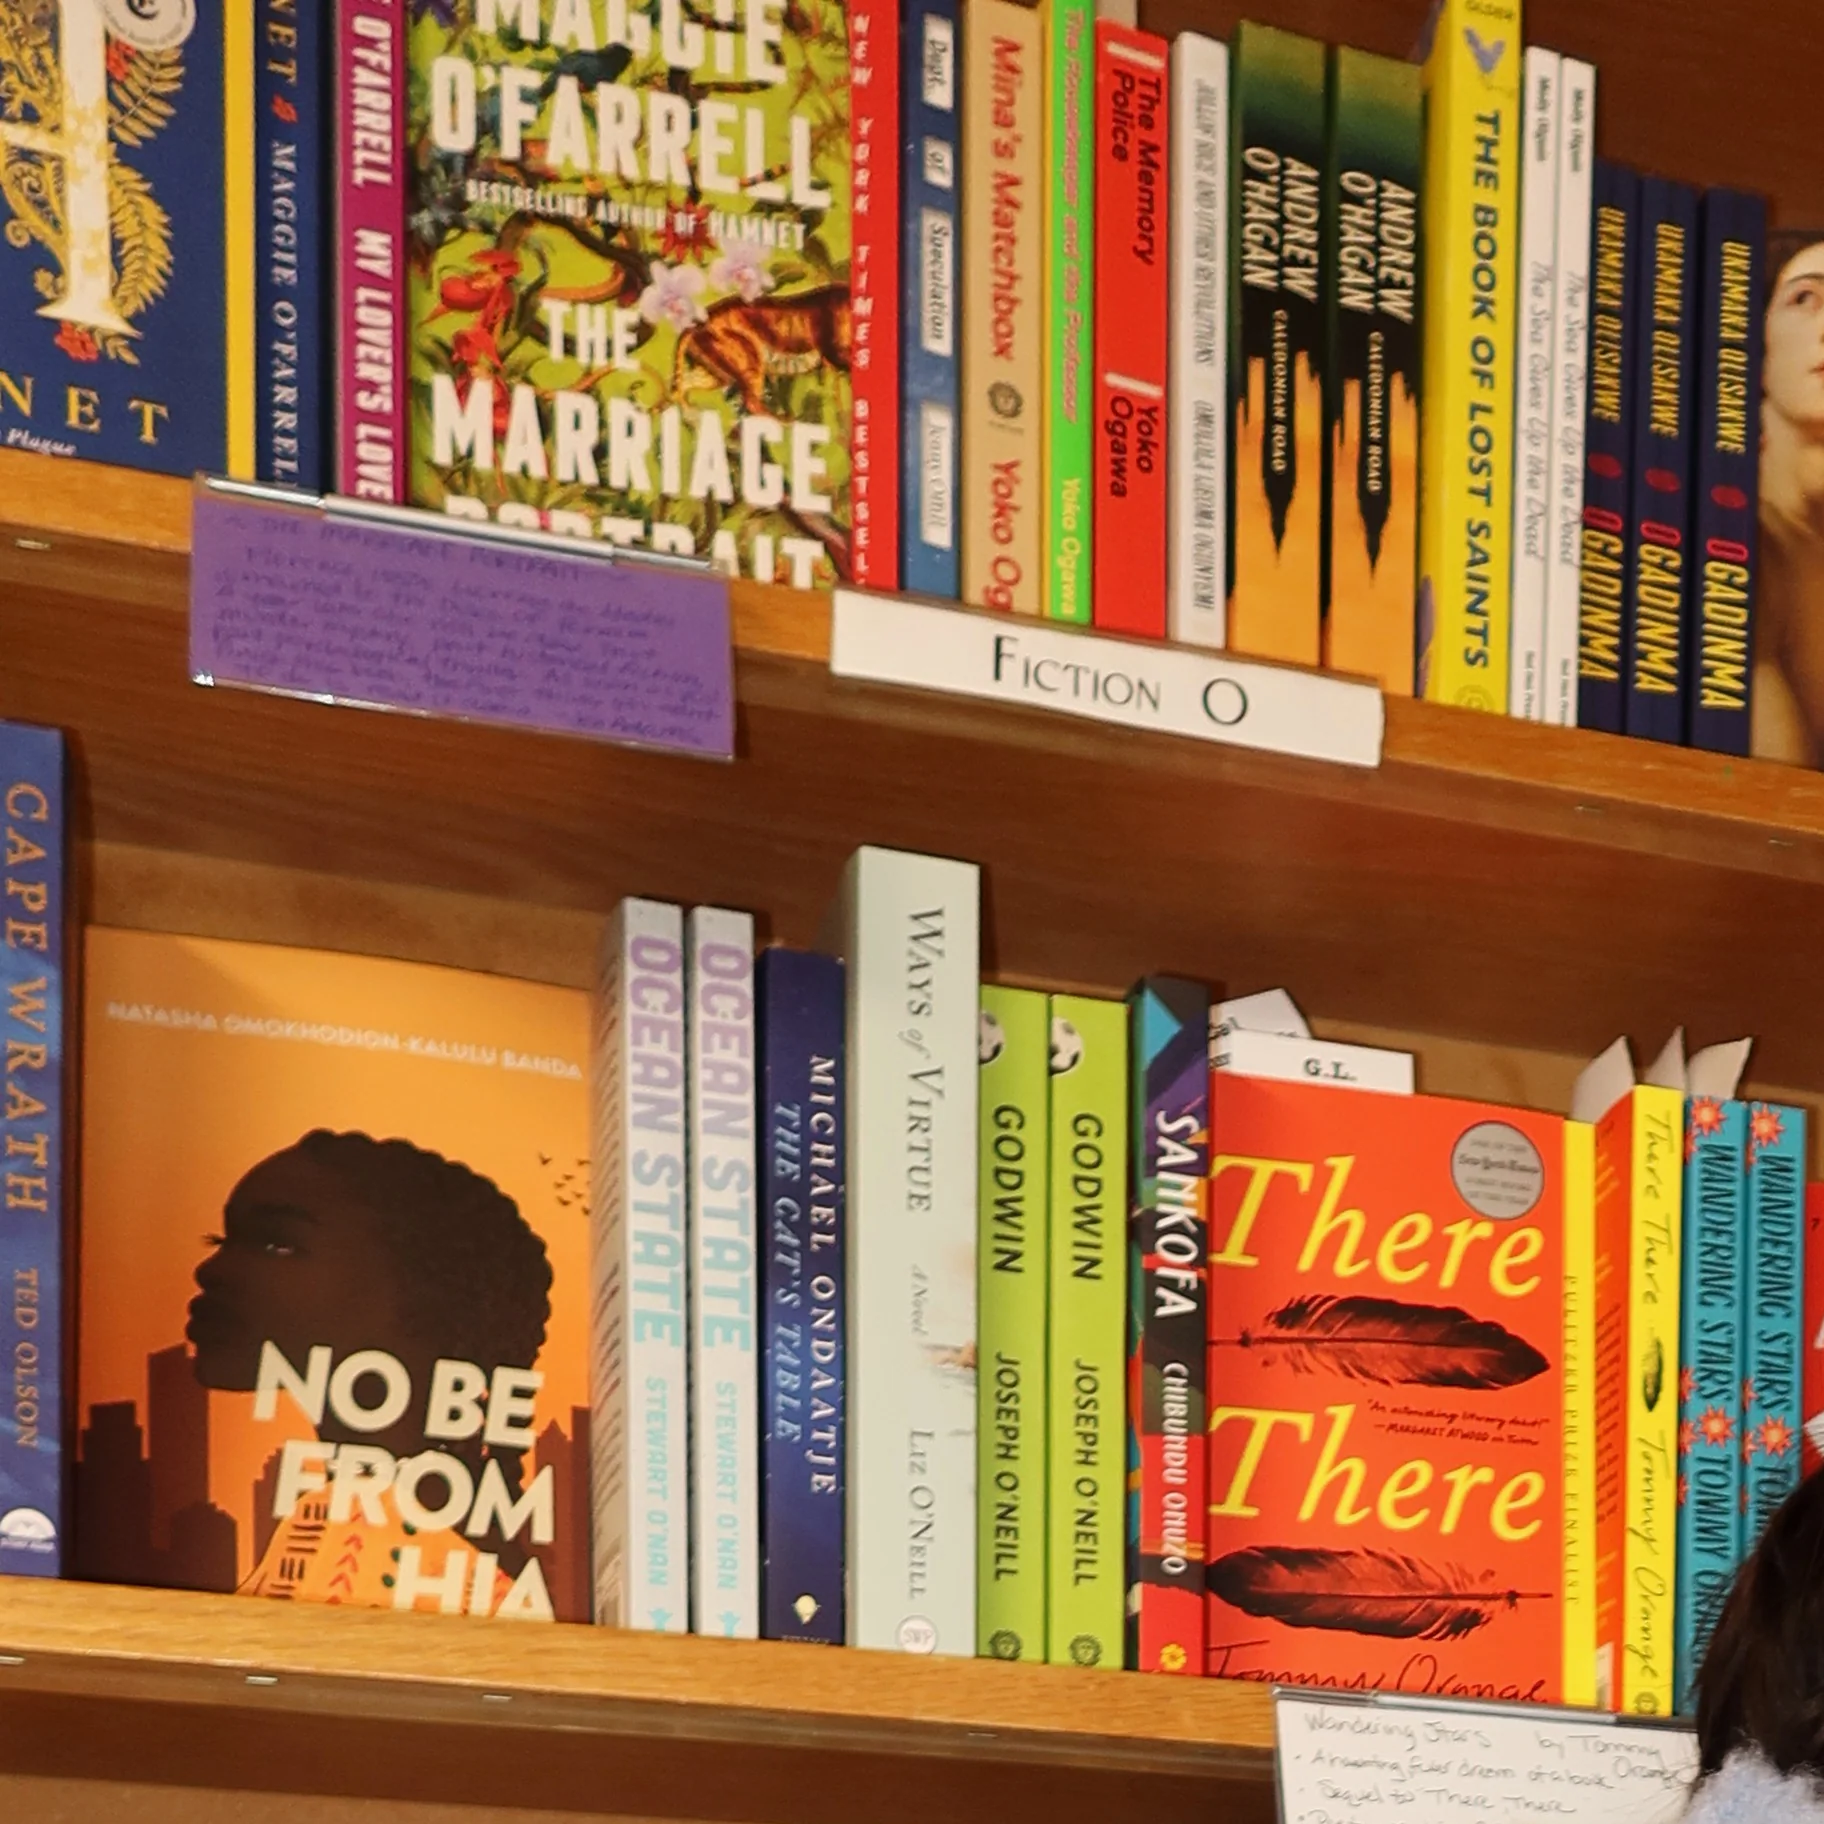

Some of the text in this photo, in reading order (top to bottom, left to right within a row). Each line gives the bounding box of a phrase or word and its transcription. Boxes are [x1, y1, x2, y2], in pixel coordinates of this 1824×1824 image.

[431, 56, 830, 209] O'FARRELL
[991, 36, 1022, 160] Mina's
[1112, 68, 1137, 164] Police
[1132, 75, 1161, 266] The Memory
[271, 140, 299, 288] MAGGIE
[351, 15, 394, 500] O'FARRELL MY LOVER'S LOVE
[465, 178, 806, 251] BESTSELLING AUTHOR OF HAMNET
[853, 15, 872, 370] NEW YORK TIMES
[991, 170, 1022, 358] Matchbox
[1242, 146, 1282, 292] O'HAGAN
[1280, 157, 1320, 302] ANDREW
[543, 298, 641, 370] THE
[1271, 309, 1289, 474] CALEDONIAN ROAD
[1461, 110, 1500, 668] THE BOOK OF LOST SAINTS
[431, 374, 832, 513] MARRIAGE
[990, 459, 1021, 544] Yoko
[1104, 396, 1133, 498] Ogawa
[1136, 405, 1158, 474] Yoko
[1635, 520, 1682, 694] OGADINMA
[1699, 538, 1748, 711] OGADINMA
[1202, 678, 1249, 726] O
[2, 782, 50, 1449] CAPE WRATH TED OLSON
[628, 936, 682, 1505] OCEAN STATE STEWART
[774, 1104, 802, 1444] THE CAT'S TABLE
[810, 1055, 837, 1495] MICHAEL ONDAATJE
[1210, 1154, 1545, 1297] There
[1641, 1110, 1674, 1306] There There
[252, 1339, 545, 1450] NO BE
[991, 1106, 1027, 1583] GODWIN JOSEPH O'NEILL
[1154, 1109, 1199, 1575] SANKOFA CHIBUNDU ONUZO
[1693, 1143, 1738, 1562] WANDERING STARS TOMMY
[272, 1438, 554, 1546] FROM
[1208, 1404, 1545, 1541] There
